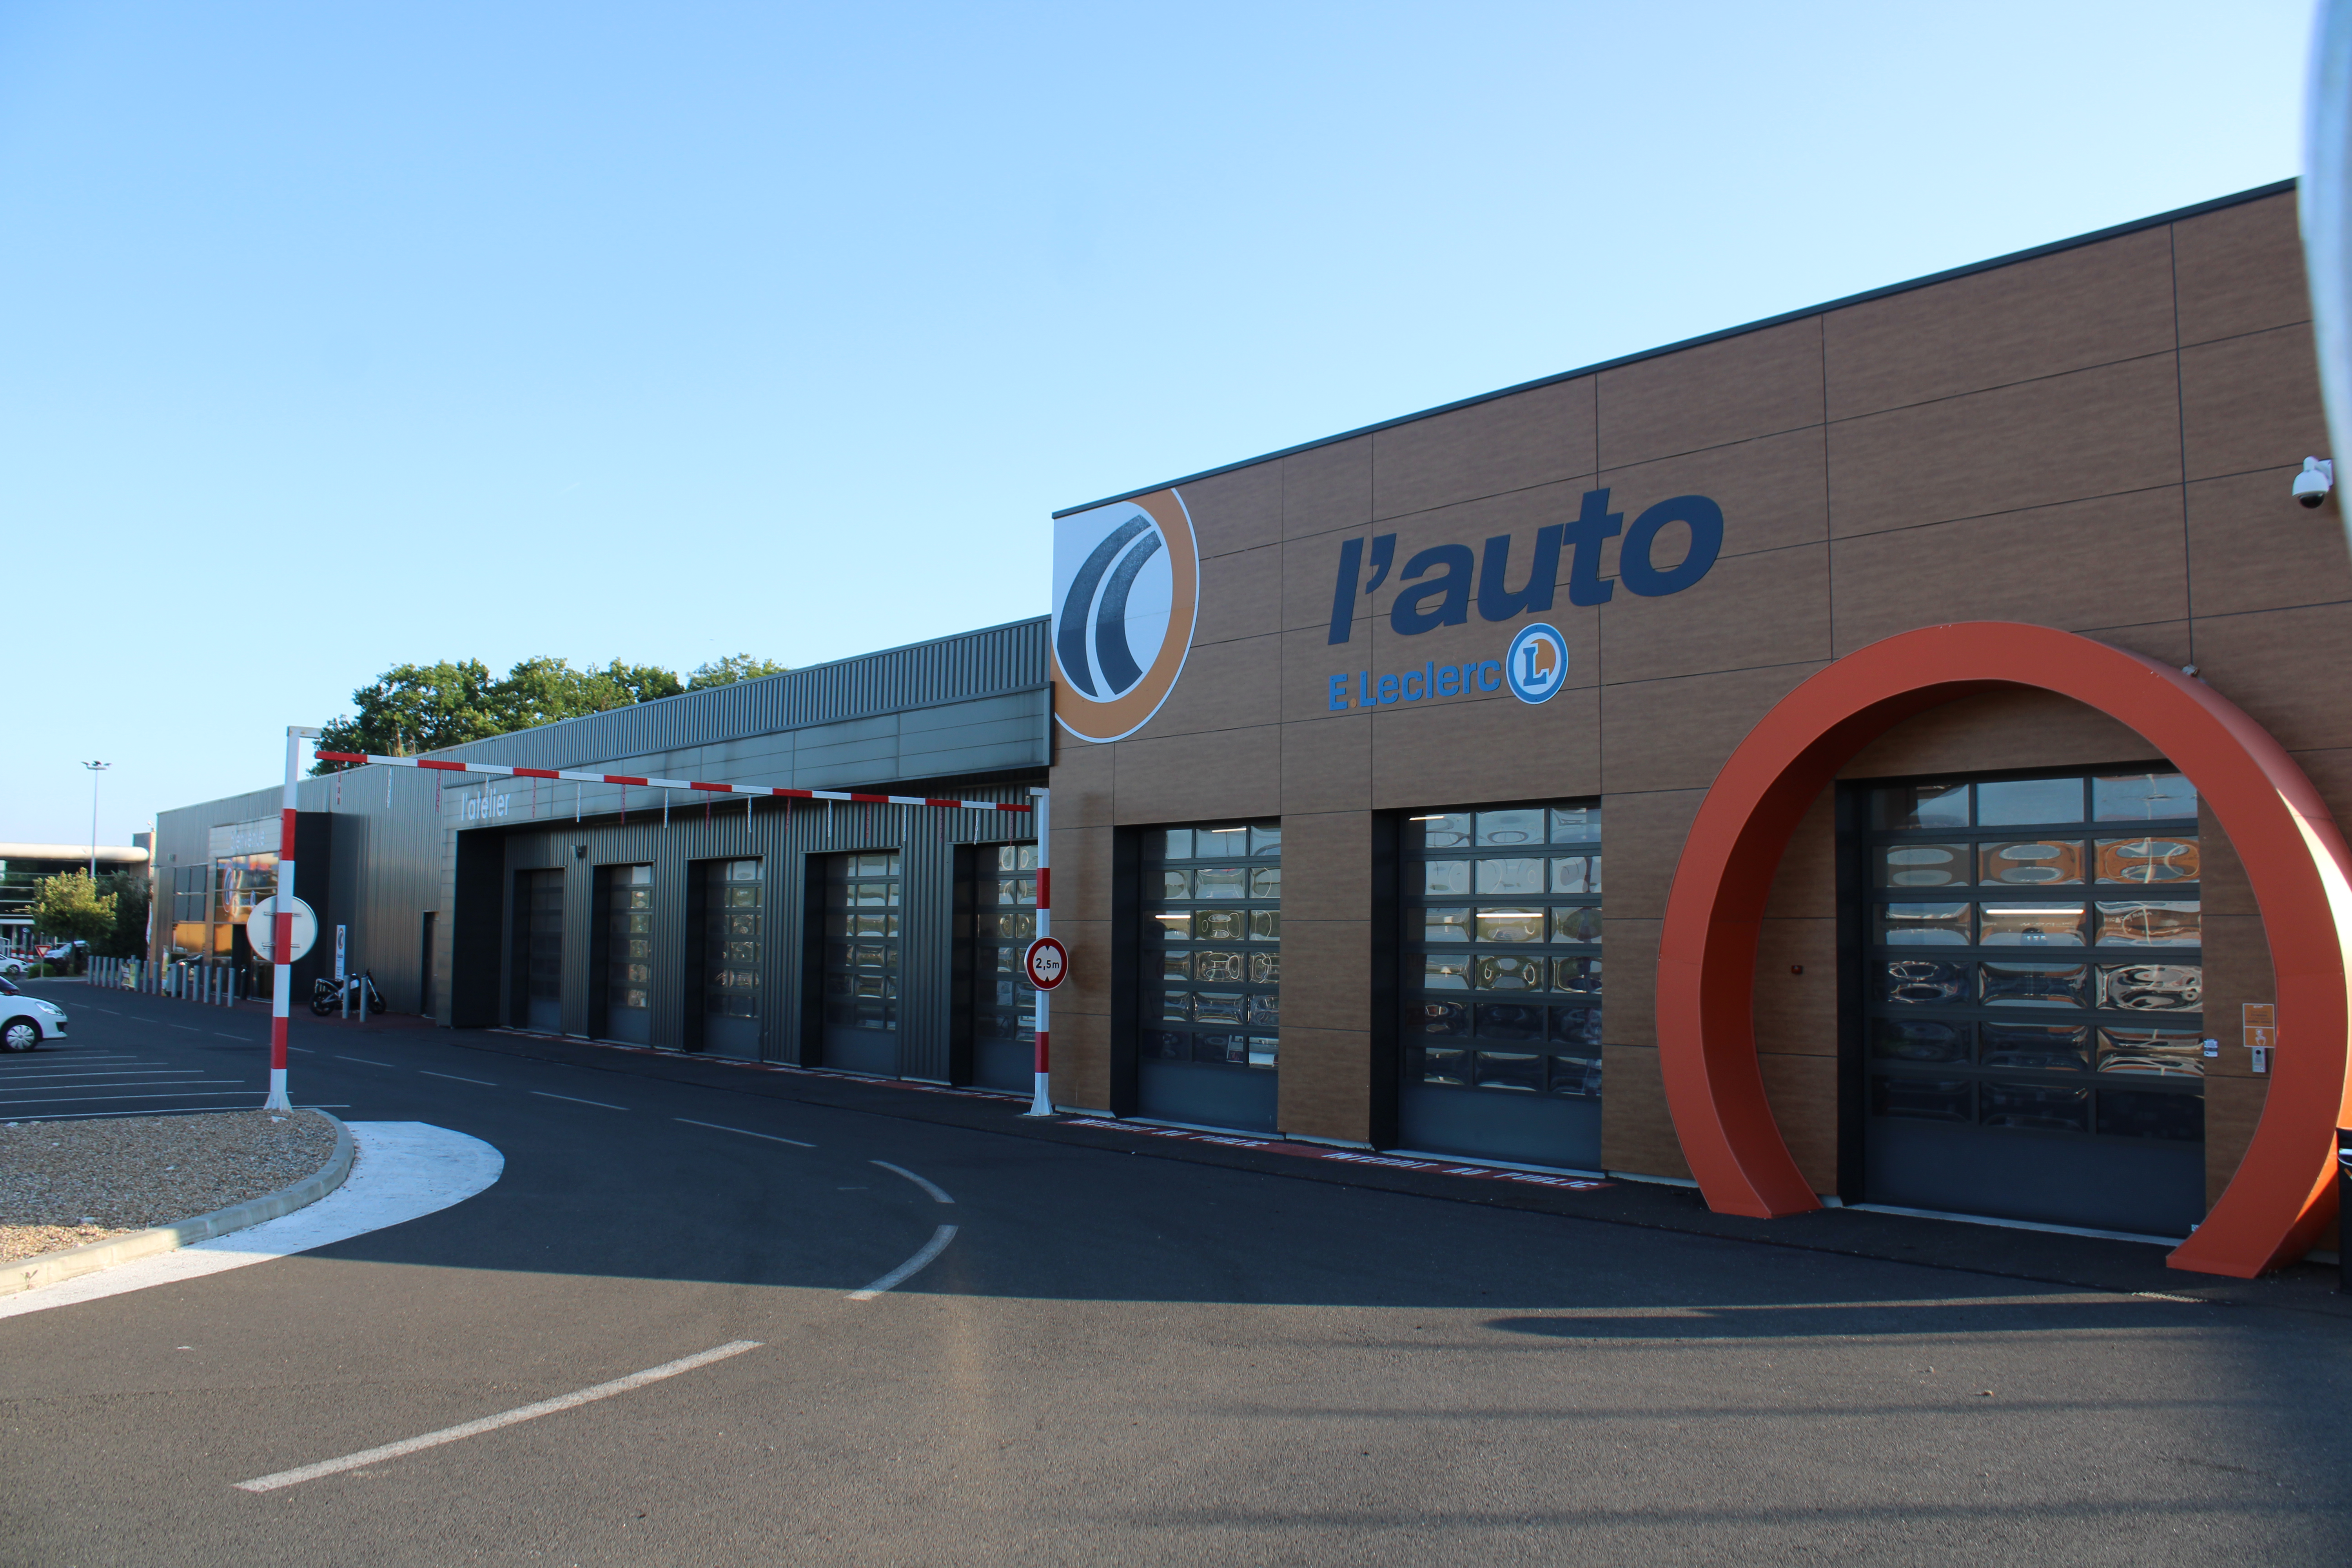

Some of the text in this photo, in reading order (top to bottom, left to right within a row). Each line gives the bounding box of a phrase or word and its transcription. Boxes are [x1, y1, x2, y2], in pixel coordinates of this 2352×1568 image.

[1327, 487, 1724, 646] l'auto
[1329, 661, 1501, 710] E.Leclerc
[1523, 642, 1550, 687] L
[461, 788, 510, 821] l'atelier
[1321, 1152, 1439, 1169] INTERDIT
[1494, 1172, 1599, 1189] PUBLIC
